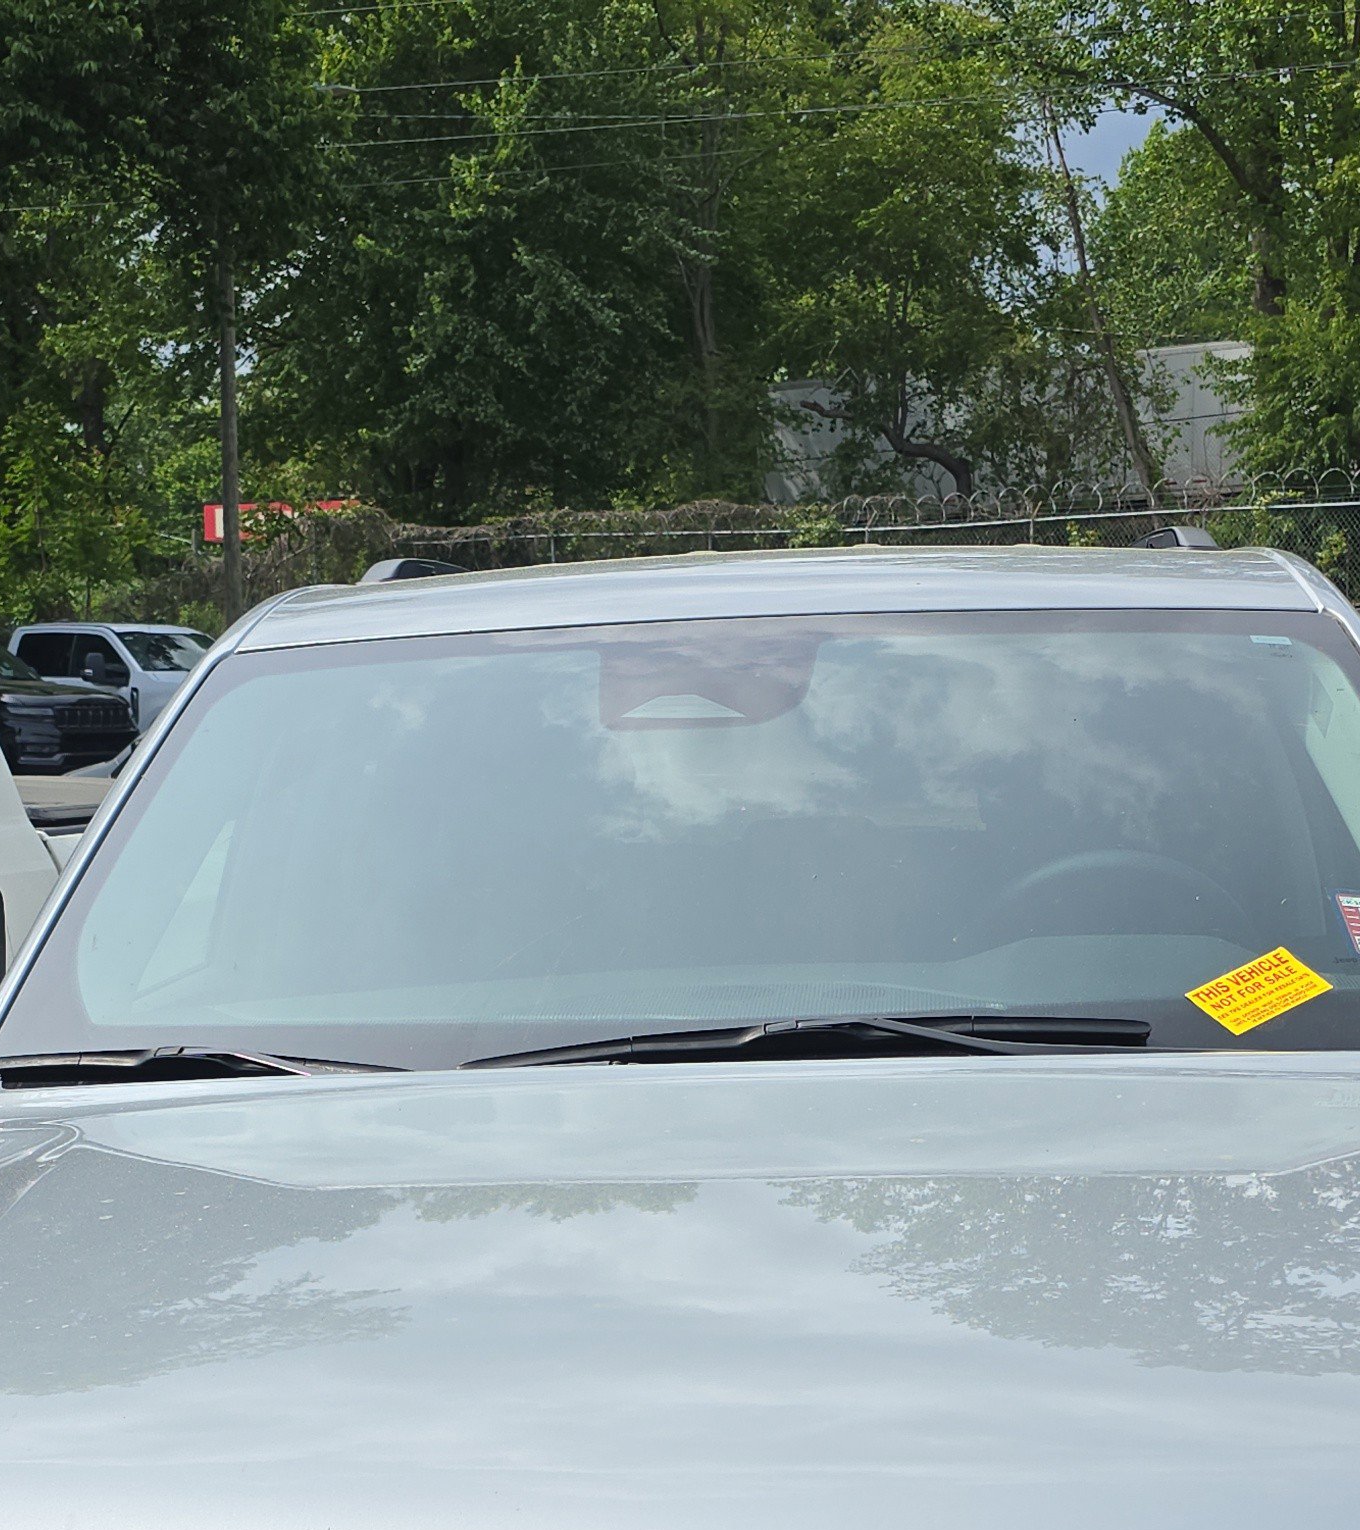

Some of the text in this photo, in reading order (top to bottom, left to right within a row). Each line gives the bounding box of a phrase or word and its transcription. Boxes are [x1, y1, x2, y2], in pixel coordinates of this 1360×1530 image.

[1191, 981, 1231, 1003] THIS
[1225, 952, 1289, 986] VEHICLE
[1209, 965, 1297, 1011] NOT FOR SALE
